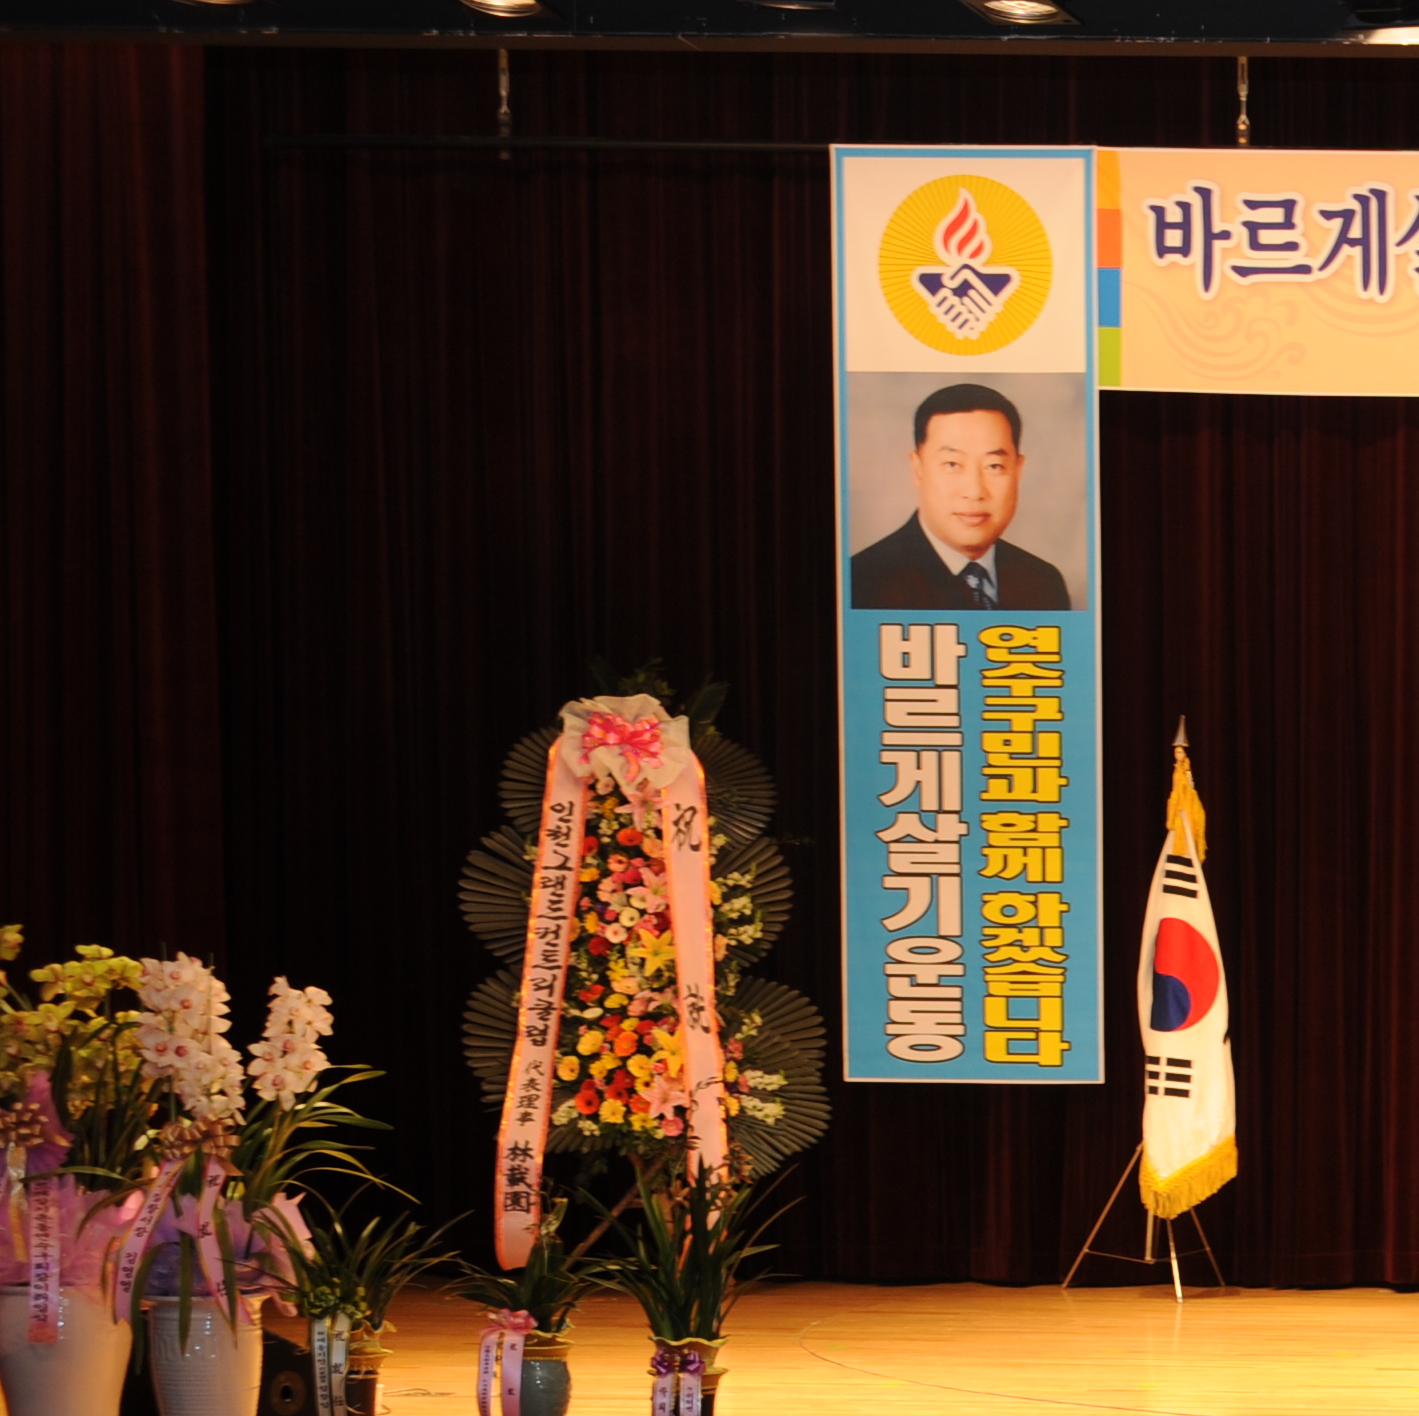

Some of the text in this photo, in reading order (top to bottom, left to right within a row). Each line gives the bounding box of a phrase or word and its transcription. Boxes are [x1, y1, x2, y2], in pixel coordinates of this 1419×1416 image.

[876, 623, 968, 1063] 바르게살기운동
[977, 624, 1072, 1068] 연수구민과 함께 하겠습니다
